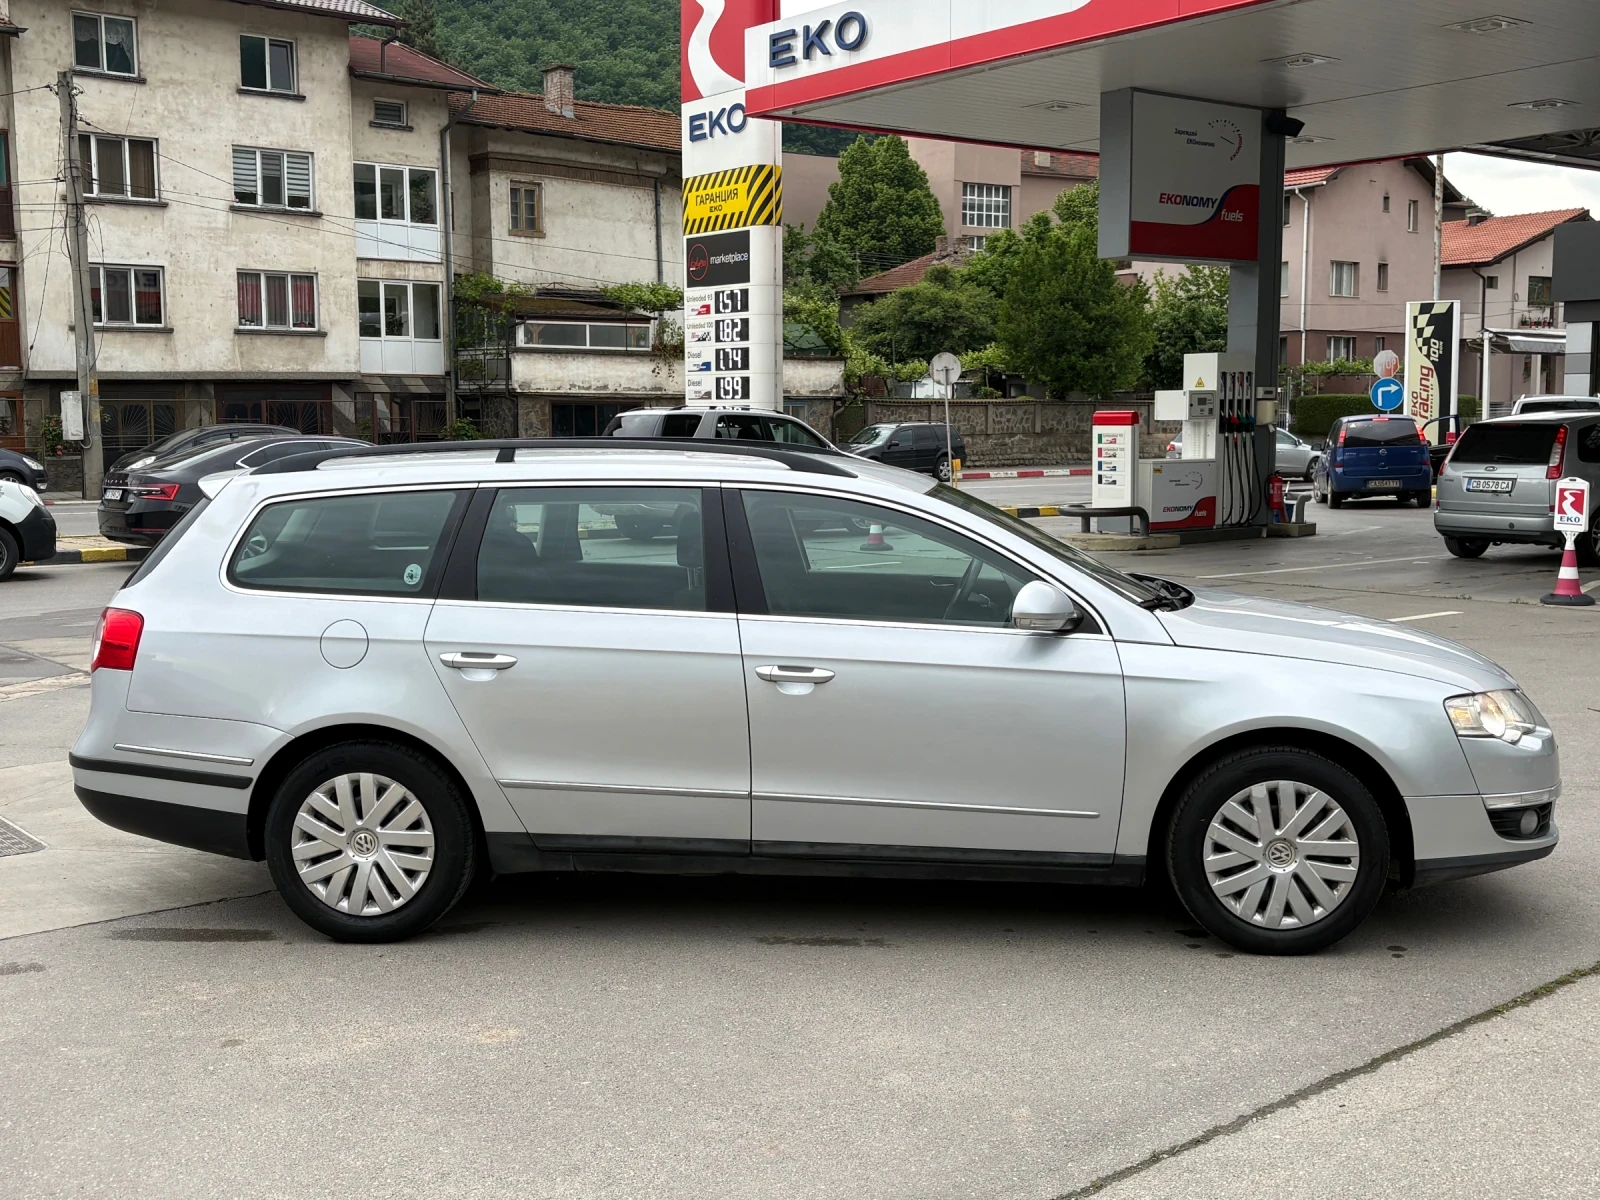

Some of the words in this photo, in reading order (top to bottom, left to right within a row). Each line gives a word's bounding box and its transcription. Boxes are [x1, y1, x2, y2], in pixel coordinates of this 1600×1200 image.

[769, 11, 869, 69] EKO
[688, 102, 748, 144] EKO
[695, 187, 739, 206] ГАРАНЦИЯ
[1158, 192, 1218, 209] EKONOMY
[1220, 208, 1244, 222] fuels
[709, 251, 749, 265] marketplace
[686, 294, 706, 303] Unleaded
[686, 322, 706, 330] Unleaded
[687, 350, 702, 359] Diesel
[1430, 338, 1439, 362] 100
[687, 378, 703, 387] Diesel
[1418, 364, 1434, 420] racing
[1411, 390, 1419, 417] EKO
[1162, 505, 1194, 513] EKONOMY
[1559, 515, 1581, 524] EKO
